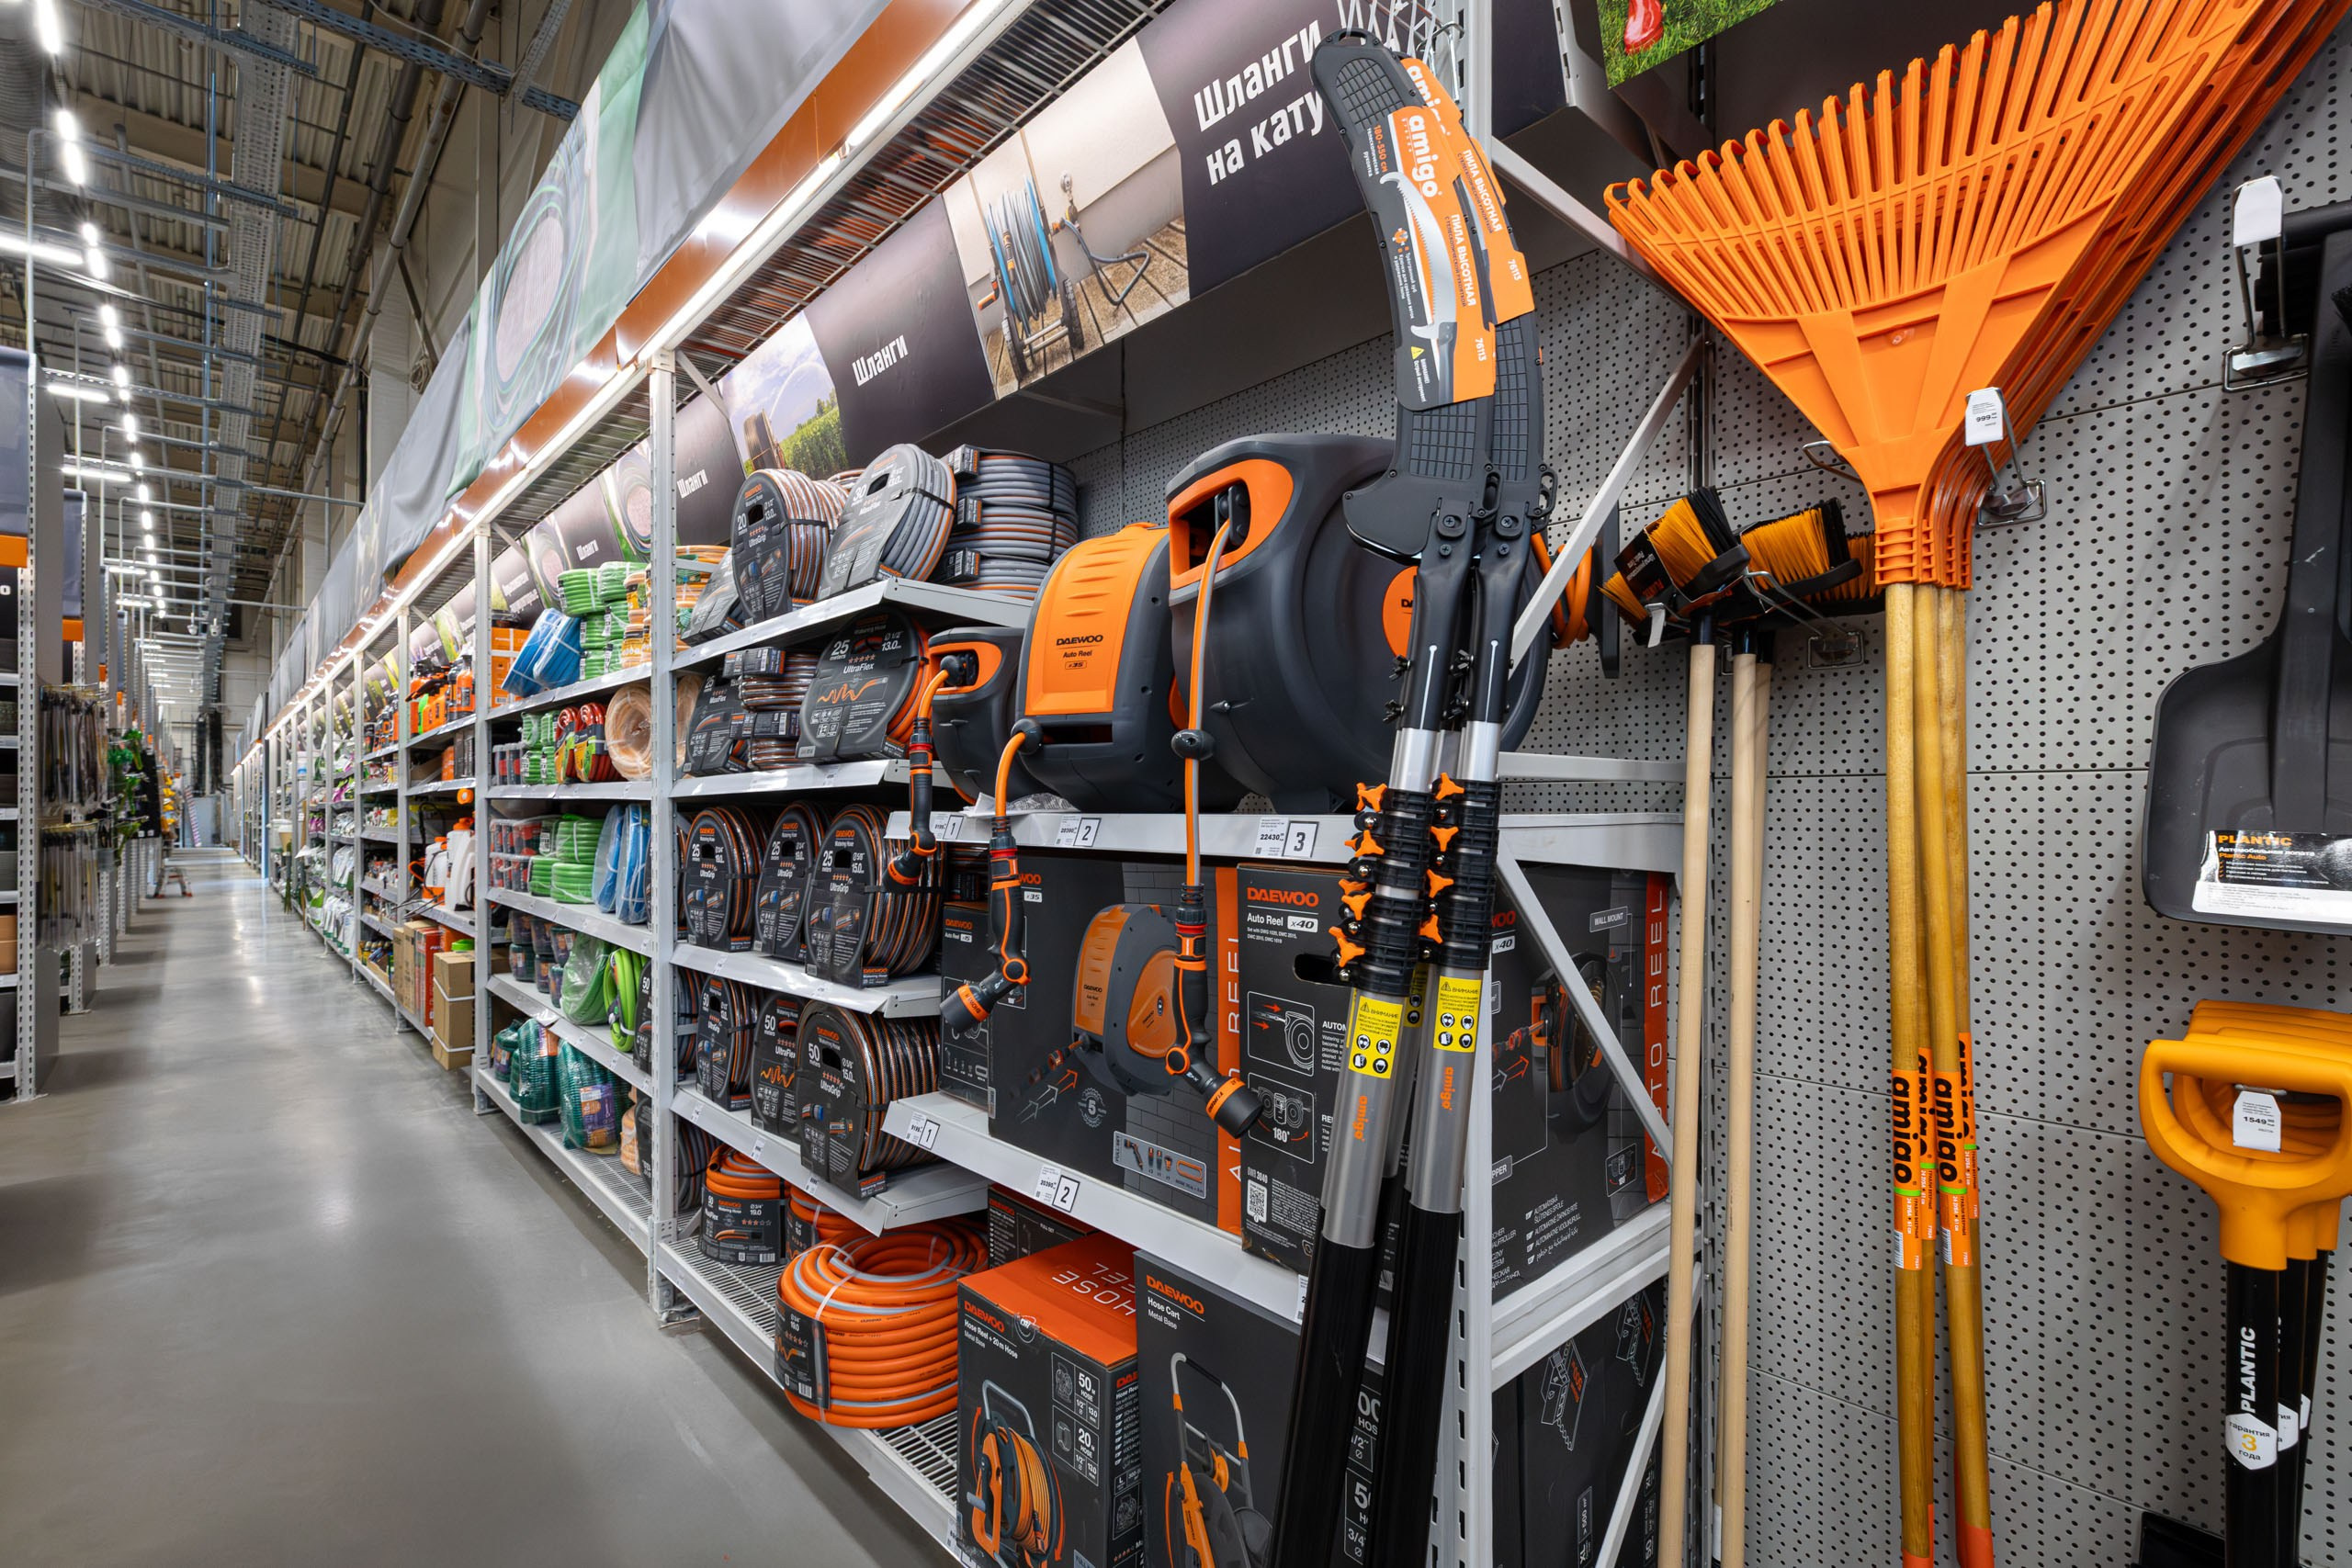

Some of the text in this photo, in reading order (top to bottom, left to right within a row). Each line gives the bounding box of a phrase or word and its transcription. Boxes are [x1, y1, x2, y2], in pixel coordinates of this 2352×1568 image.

[1193, 19, 1322, 132] Шланги
[1374, 125, 1386, 161] 180-550
[1205, 138, 1245, 186] на
[1408, 115, 1440, 197] amigo
[1463, 149, 1503, 233] ПИЛА ВЫСОТНАЯ
[1452, 214, 1476, 306] ПИЛА ВЫСОТНАЯ
[1508, 259, 1522, 281] 76113
[1475, 338, 1487, 362] 76113
[852, 334, 909, 387] Шланги
[1975, 413, 1992, 423] 999
[676, 469, 708, 499] Шланги
[852, 484, 867, 502] 30
[737, 513, 747, 532] 20
[831, 639, 850, 656] 25
[1056, 634, 1103, 646] DAEWOO
[843, 662, 874, 674] UltraFlex
[950, 822, 956, 836] 1
[1081, 825, 1091, 840] 2
[772, 841, 781, 855] 25
[1293, 831, 1306, 852] 3
[2218, 834, 2293, 846] PLANTIC
[692, 844, 700, 857] 25
[822, 851, 833, 867] 25
[2219, 846, 2283, 855] Автомобильная
[830, 882, 849, 894] UltraGrip
[1247, 887, 1319, 908] DAEWOO
[944, 919, 973, 930] DAEWOO
[1247, 912, 1315, 930] Auto Reel x40
[1594, 912, 1623, 926] WALL MOUNT
[1494, 938, 1513, 951] x40
[1650, 889, 1663, 1008] REEL
[642, 976, 650, 989] 50
[764, 1014, 775, 1031] 50
[775, 1045, 797, 1058] UltraFlex
[808, 1043, 820, 1062] 50
[820, 1080, 841, 1099] UltraGrip
[1440, 1066, 1455, 1108] amigo
[1088, 1100, 1096, 1115] 5
[1352, 1096, 1368, 1140] amigo
[2244, 1116, 2267, 1125] 1549
[926, 1129, 933, 1143] 1
[1272, 1127, 1290, 1143] 180°
[1893, 1076, 1919, 1184] amigo
[1935, 1077, 1962, 1182] amigo
[1060, 1186, 1069, 1203] 2
[1051, 1270, 1136, 1315] HOSE
[1146, 1274, 1204, 1315] DAEWOO
[964, 1300, 1005, 1333] DAEWOO
[1148, 1296, 1181, 1321] Hose Cart
[1148, 1309, 1178, 1330] Metal Base
[964, 1329, 985, 1348] Metal Base
[965, 1319, 977, 1333] Hose
[978, 1326, 989, 1340] Reel
[1005, 1344, 1018, 1359] Hose
[2240, 1326, 2256, 1414] PLANTIC
[1079, 1372, 1091, 1392] 50
[1080, 1389, 1093, 1403] HOSE
[1088, 1406, 1098, 1418] 13.0
[1358, 1416, 1378, 1435] HOS
[2229, 1419, 2270, 1438] гарантия
[1078, 1427, 1091, 1448] 20
[2241, 1434, 2257, 1451] 3
[1080, 1445, 1093, 1459] HOSE
[2238, 1449, 2261, 1461] года
[1087, 1462, 1097, 1474] 13.0
